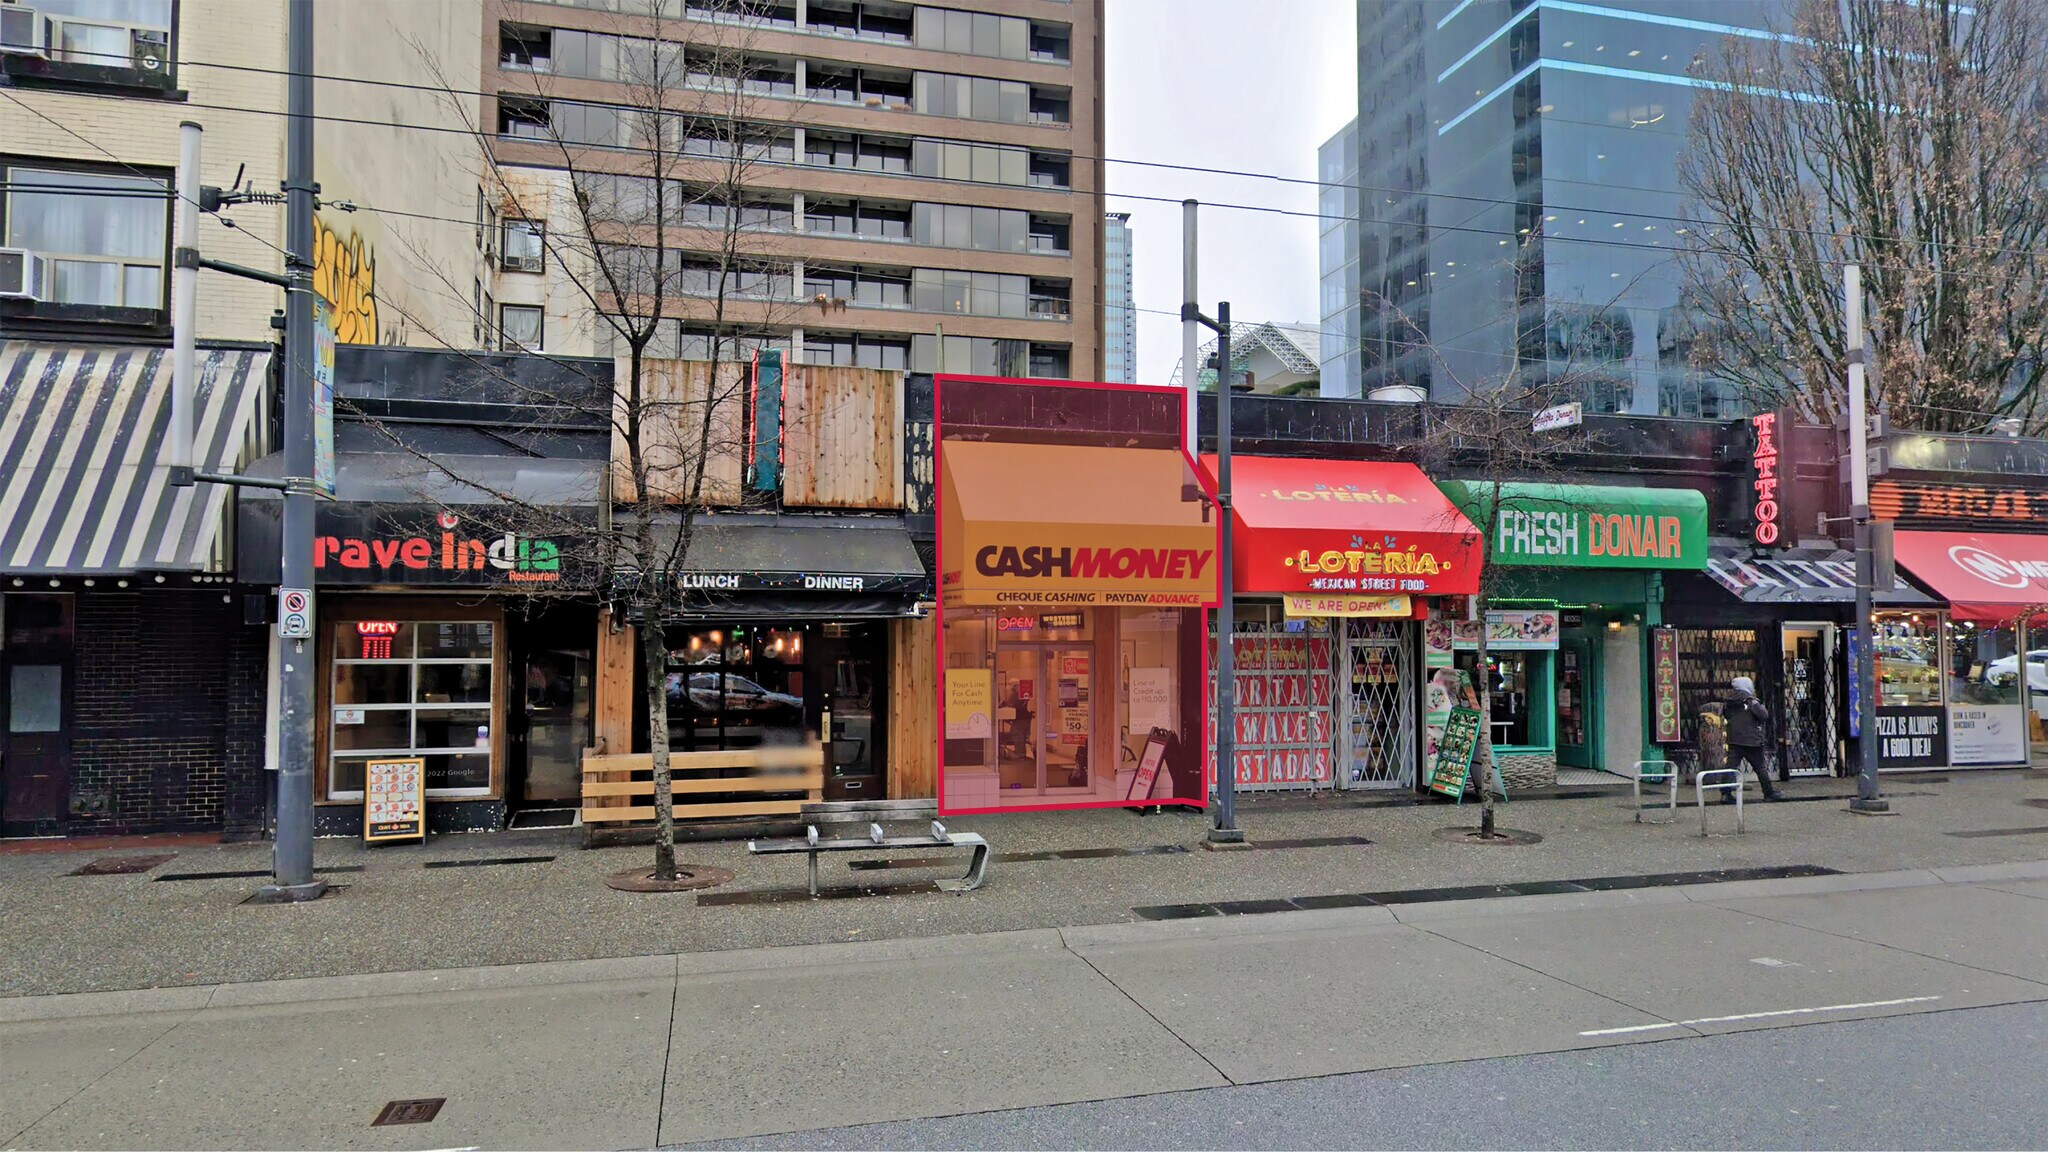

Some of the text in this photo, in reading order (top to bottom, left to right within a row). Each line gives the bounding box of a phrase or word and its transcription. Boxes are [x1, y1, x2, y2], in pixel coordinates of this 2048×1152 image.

[1753, 413, 1778, 544] TATTOO
[1272, 490, 1408, 504] LOTERÍA
[1499, 510, 1681, 558] FRESH DONAIR
[313, 536, 432, 569] rave
[1365, 542, 1381, 550] LA
[1299, 545, 1439, 574] LOTERÍA
[509, 571, 559, 582] Restaurant
[683, 575, 864, 589] LUNCH DINNER
[1361, 578, 1396, 590] STREET
[996, 592, 1199, 604] CHEQUE CASHING PAYDAY ADVANCE
[1292, 599, 1387, 612] WE ARE OPEN!
[358, 622, 397, 633] OPEN
[998, 617, 1034, 630] OPEN
[1657, 631, 1675, 735] TATTOO
[952, 699, 982, 707] Anytime
[1211, 716, 1322, 742] TMALES
[1875, 716, 1938, 736] PIZZA IS ALWAYS
[1883, 738, 1932, 758] A GOOD IDEA!
[1212, 752, 1326, 780] TSTADAS
